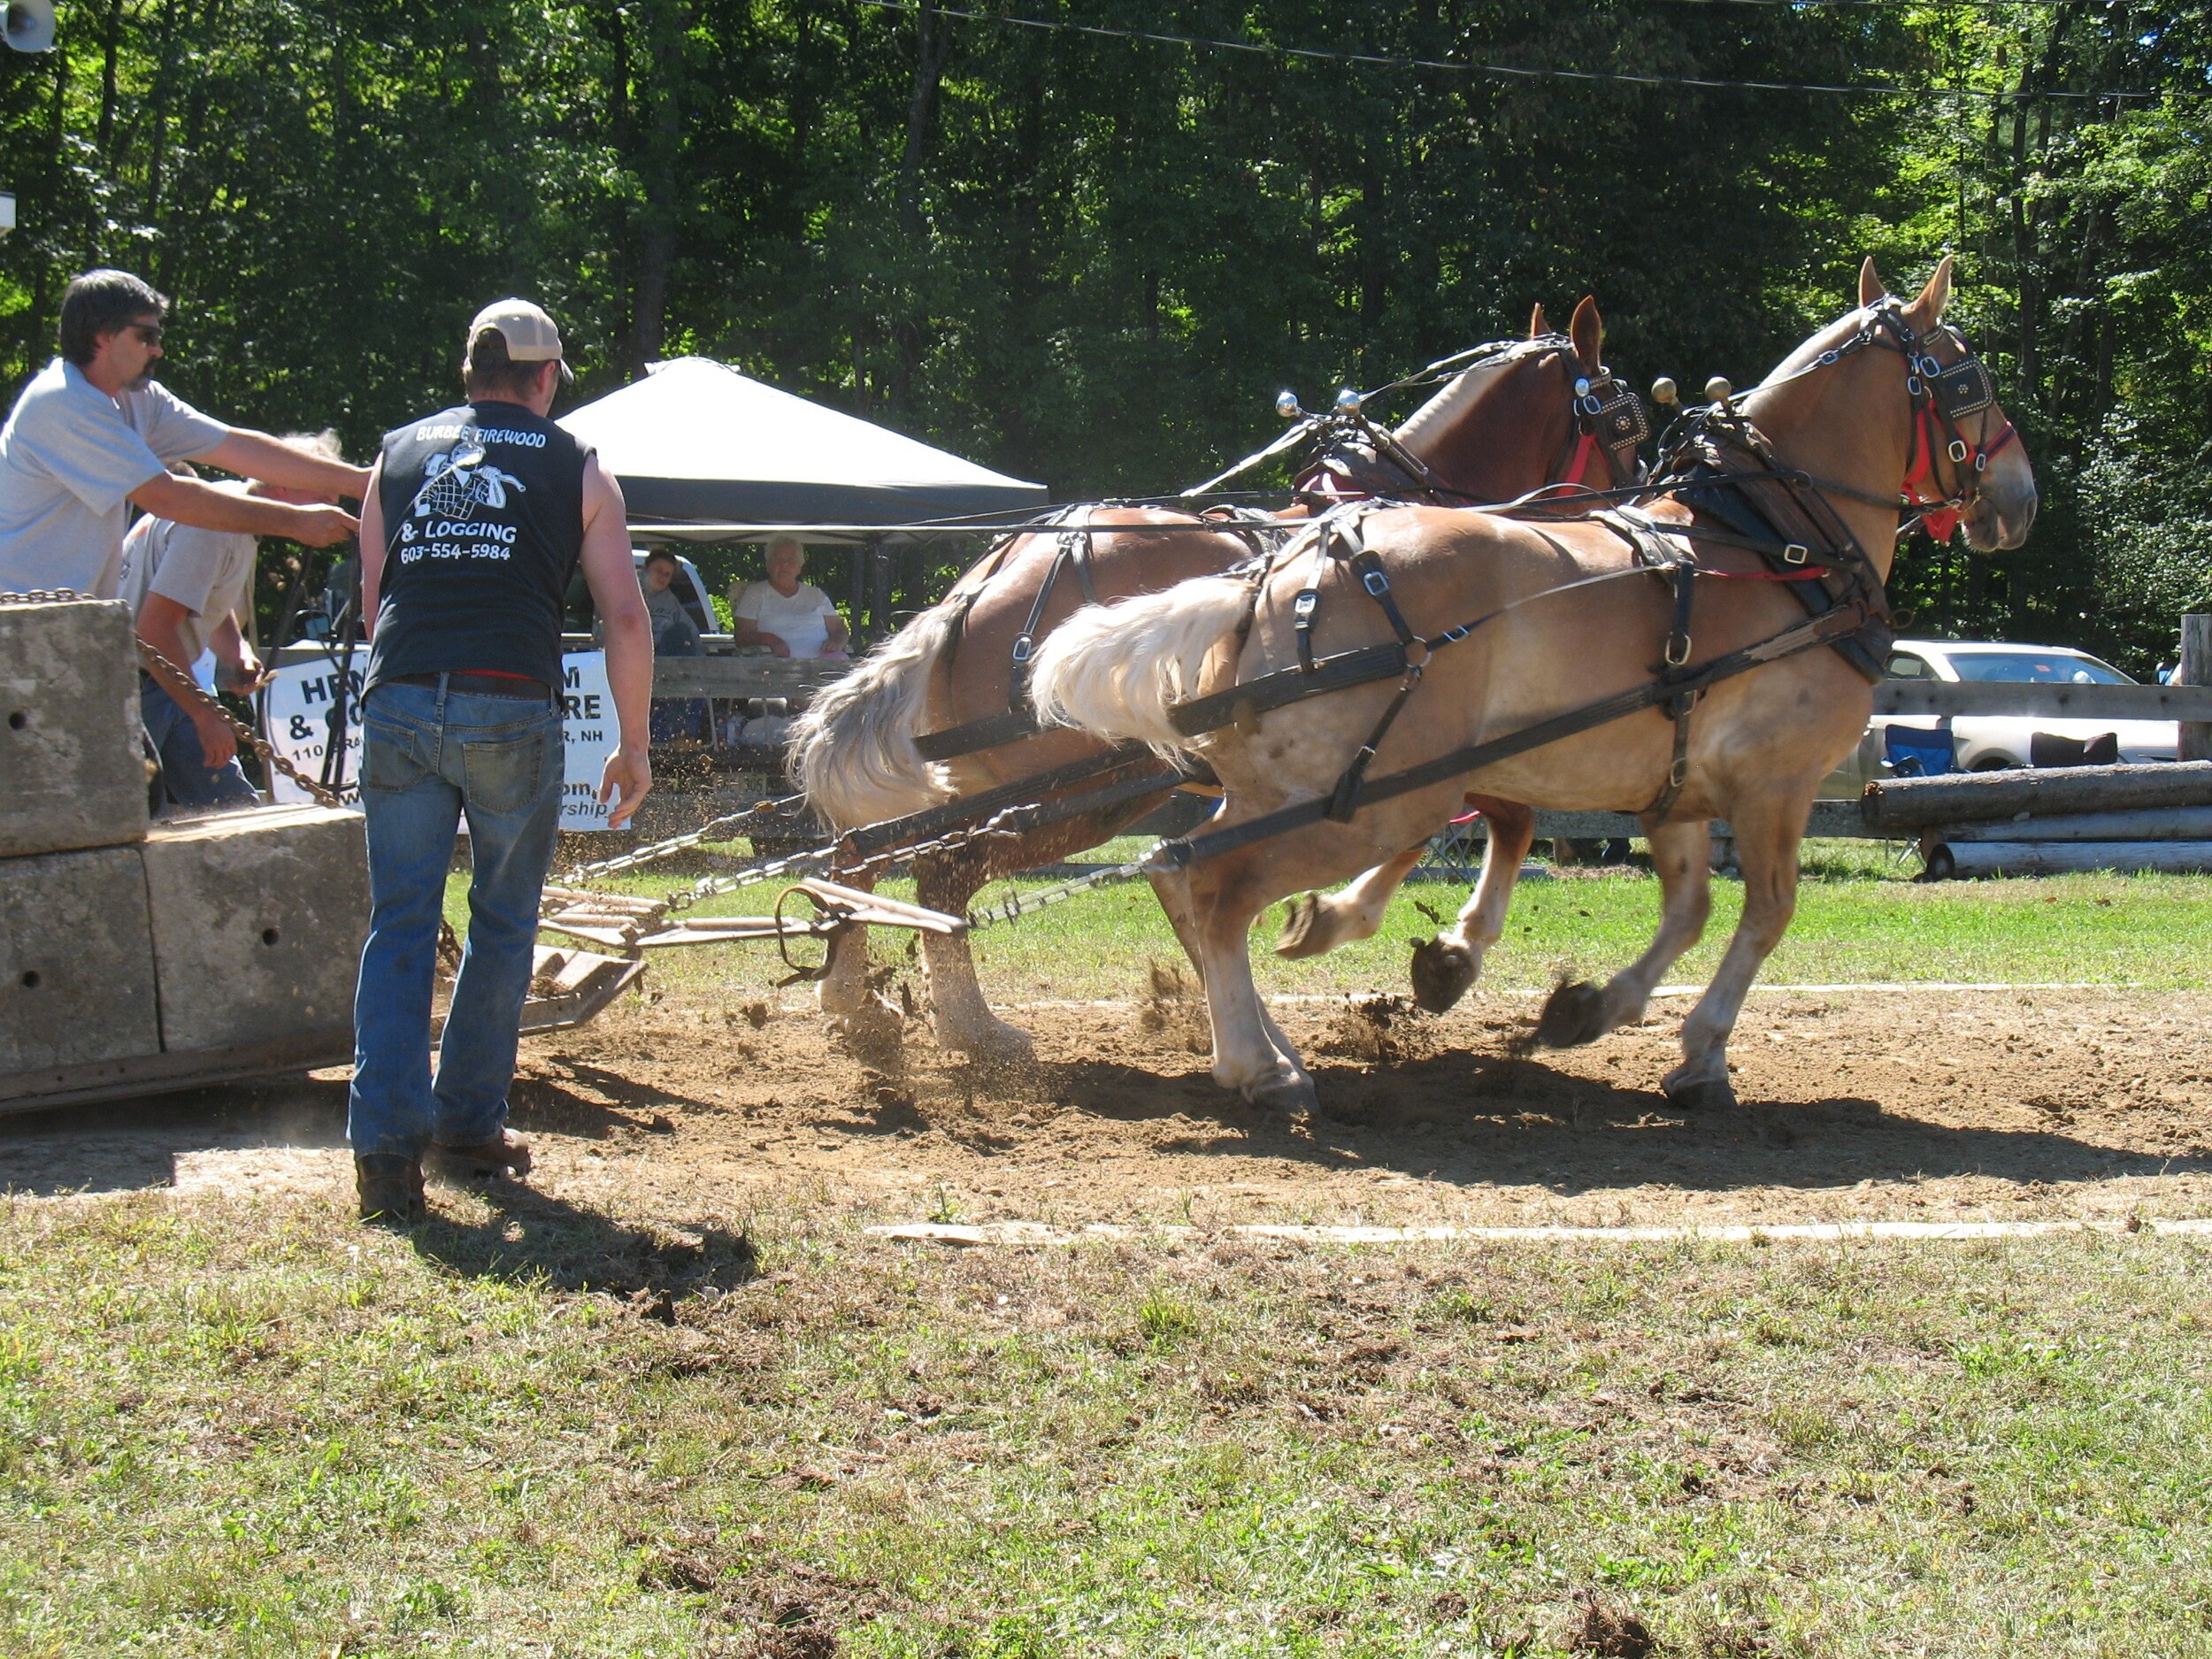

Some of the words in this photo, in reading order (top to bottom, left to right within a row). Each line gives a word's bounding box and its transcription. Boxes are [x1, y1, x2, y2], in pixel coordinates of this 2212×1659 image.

[416, 425, 472, 442] BURBEE
[473, 428, 547, 449] FIREWOOD
[401, 522, 419, 542] &
[425, 520, 518, 543] LOGGING
[401, 542, 511, 565] 603-554-5984
[290, 715, 314, 740] &
[292, 744, 324, 761] 110
[580, 730, 603, 741] NH
